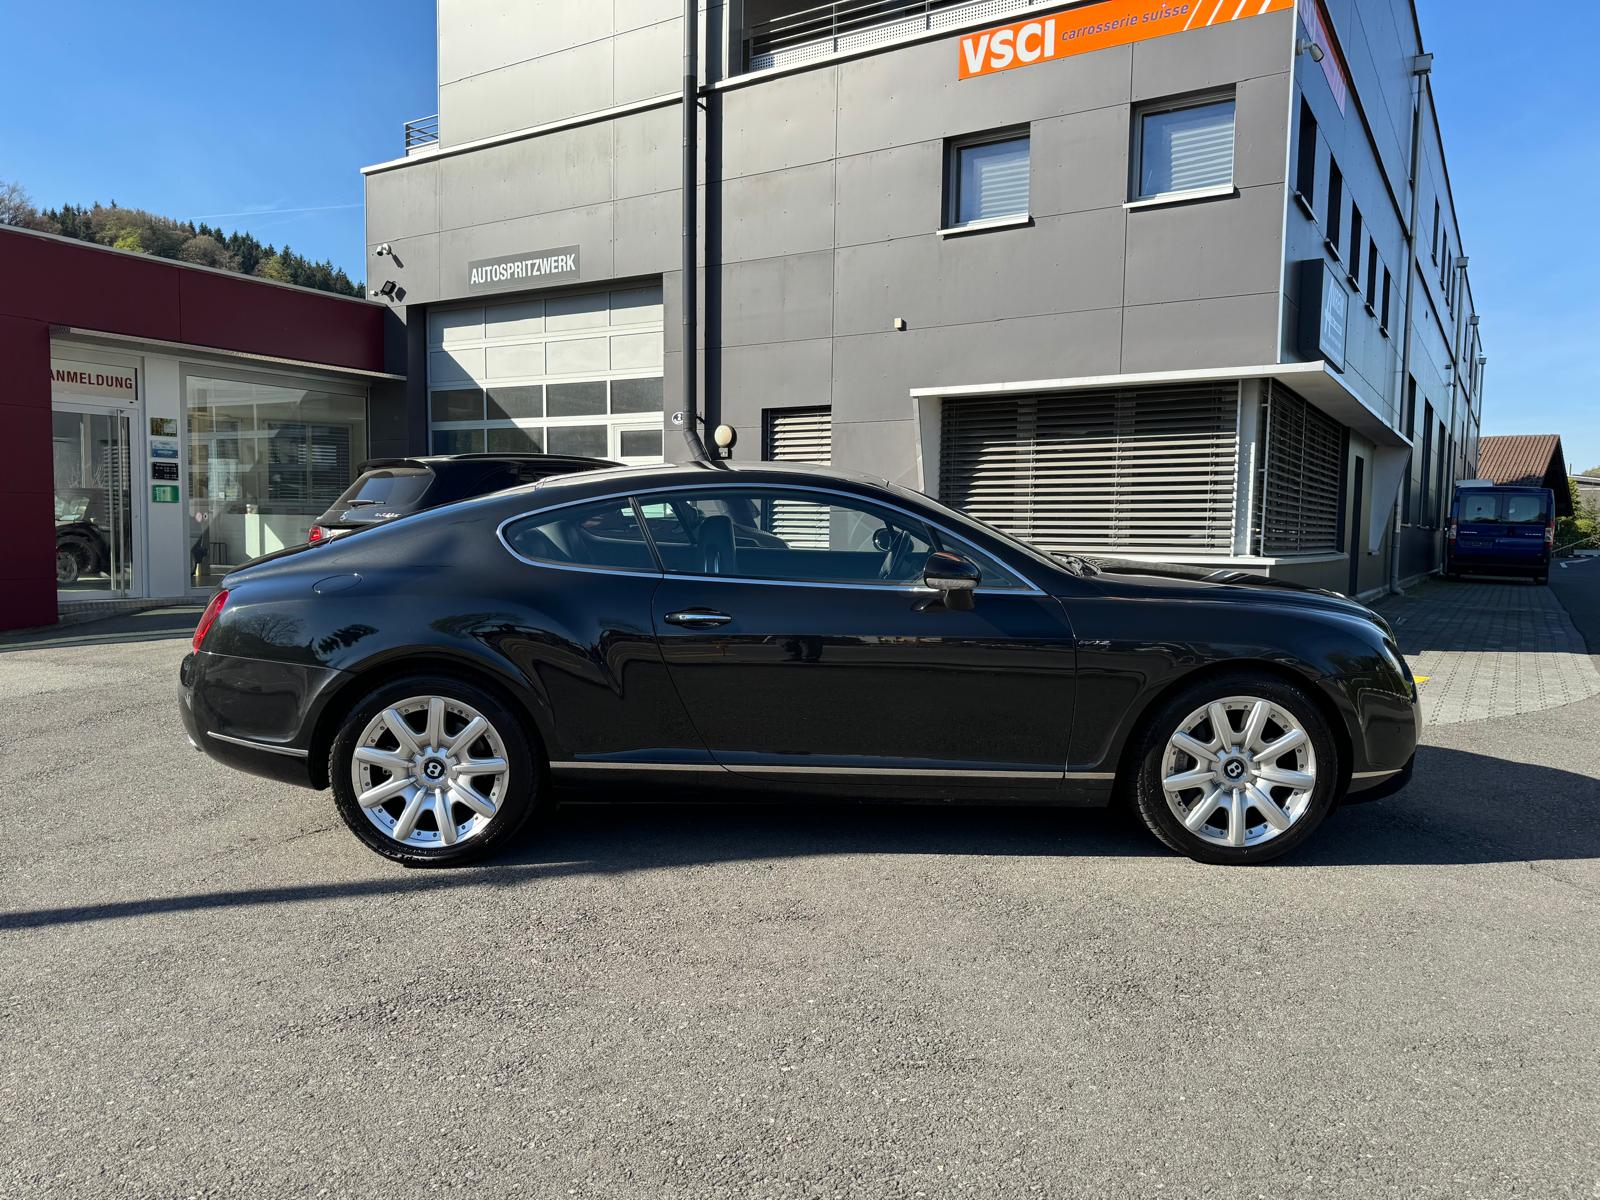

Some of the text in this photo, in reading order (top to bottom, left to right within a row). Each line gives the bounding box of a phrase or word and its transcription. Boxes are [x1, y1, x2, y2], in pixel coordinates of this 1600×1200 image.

[962, 3, 1189, 74] VSCI carrosserie suisse
[470, 253, 576, 285] AUTOSPRITZWERK
